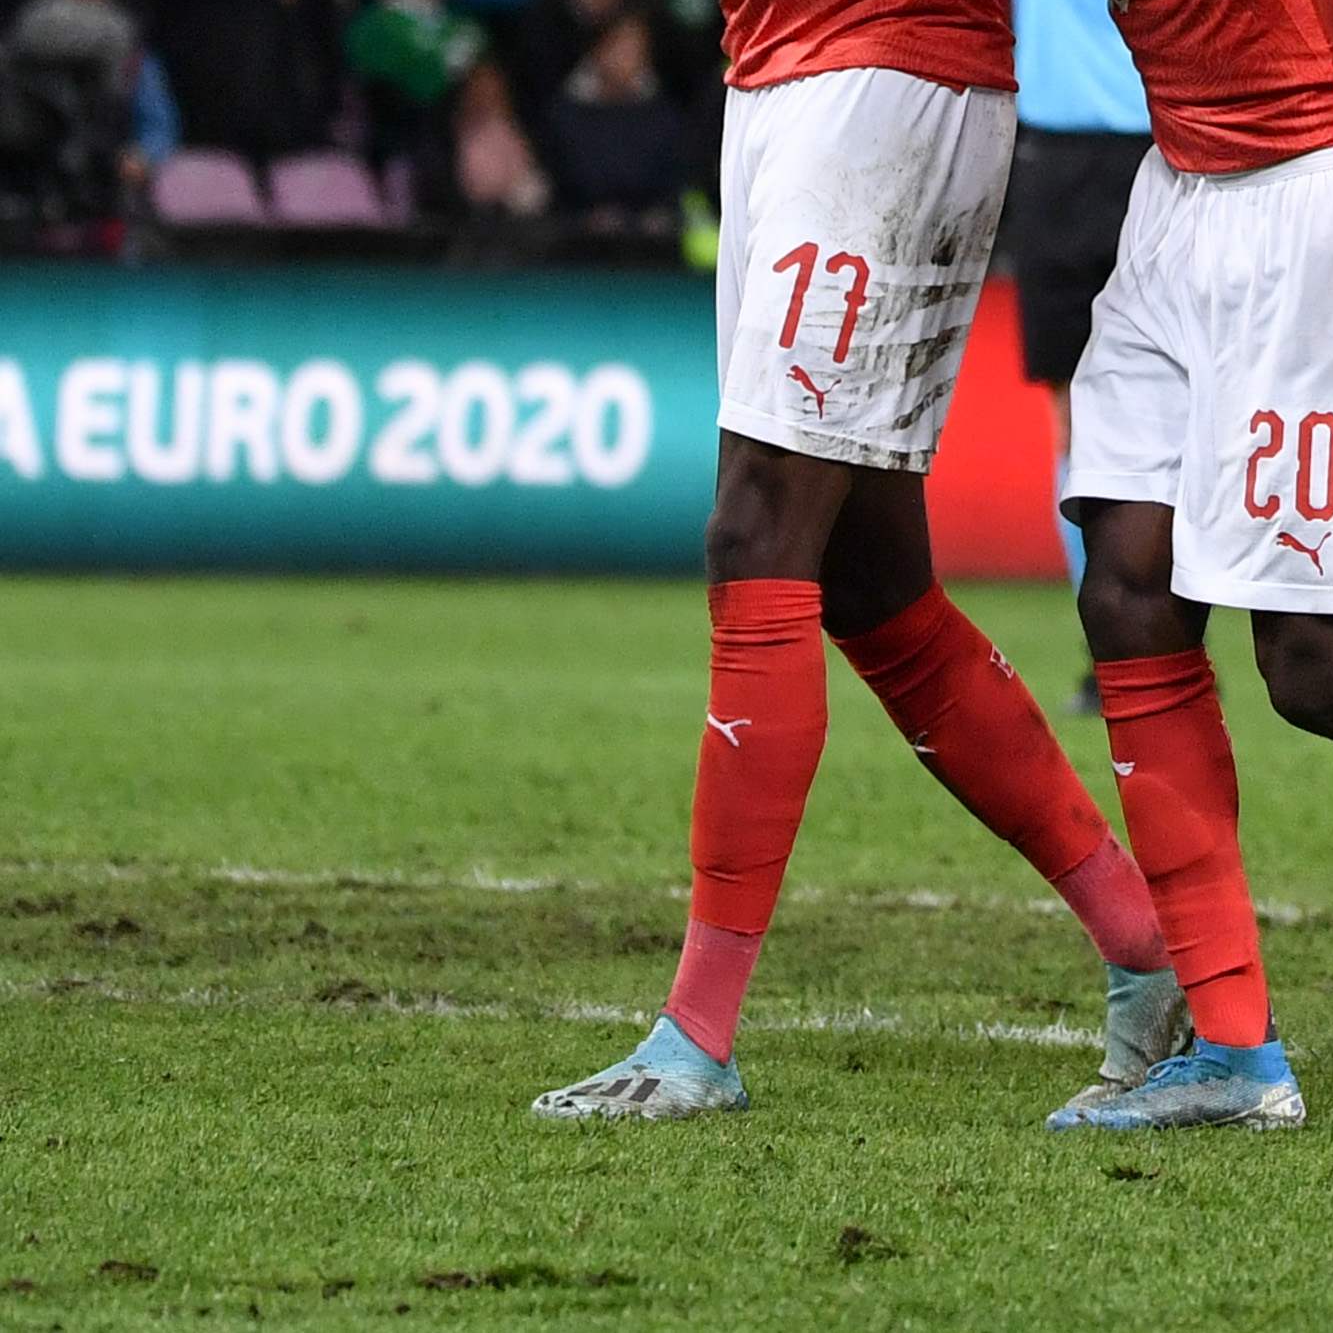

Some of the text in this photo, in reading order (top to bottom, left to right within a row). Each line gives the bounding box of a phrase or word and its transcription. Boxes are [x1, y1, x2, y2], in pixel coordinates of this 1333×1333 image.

[772, 241, 870, 364] 17
[57, 358, 363, 484] EURO
[370, 358, 653, 487] 2020
